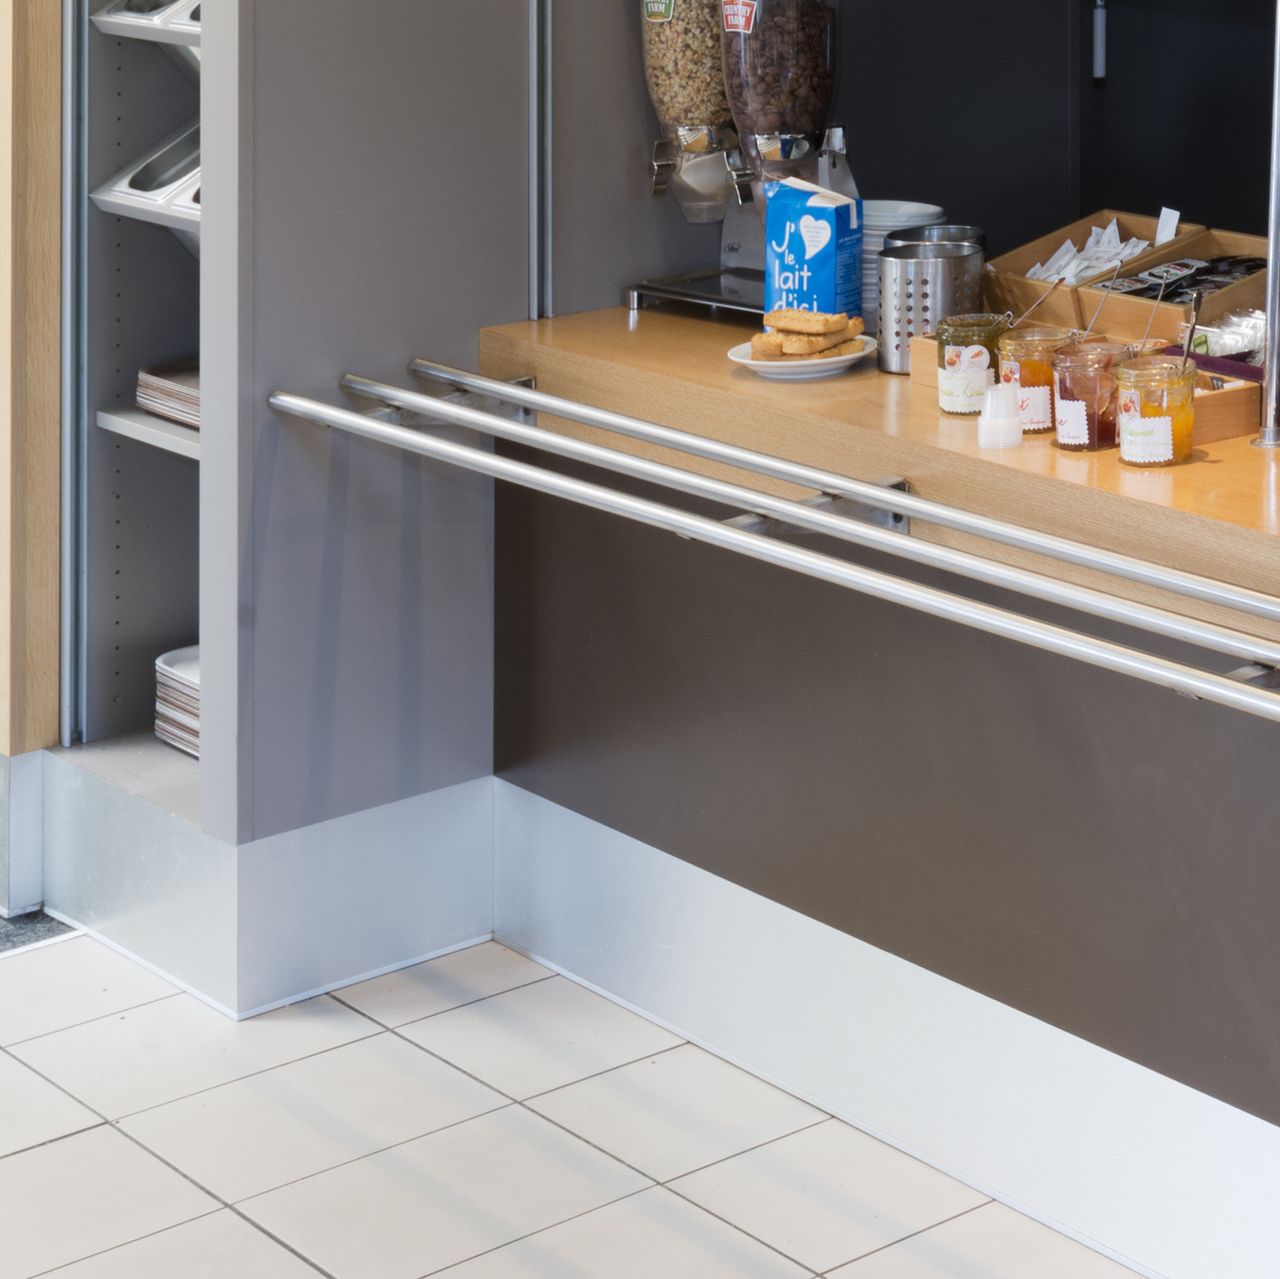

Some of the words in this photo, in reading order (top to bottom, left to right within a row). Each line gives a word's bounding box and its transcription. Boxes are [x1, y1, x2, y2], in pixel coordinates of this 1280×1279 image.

[648, 3, 665, 13] FARM
[725, 4, 752, 16] COUNTRY
[728, 15, 745, 26] FARM
[784, 249, 794, 265] le
[774, 260, 812, 291] lait
